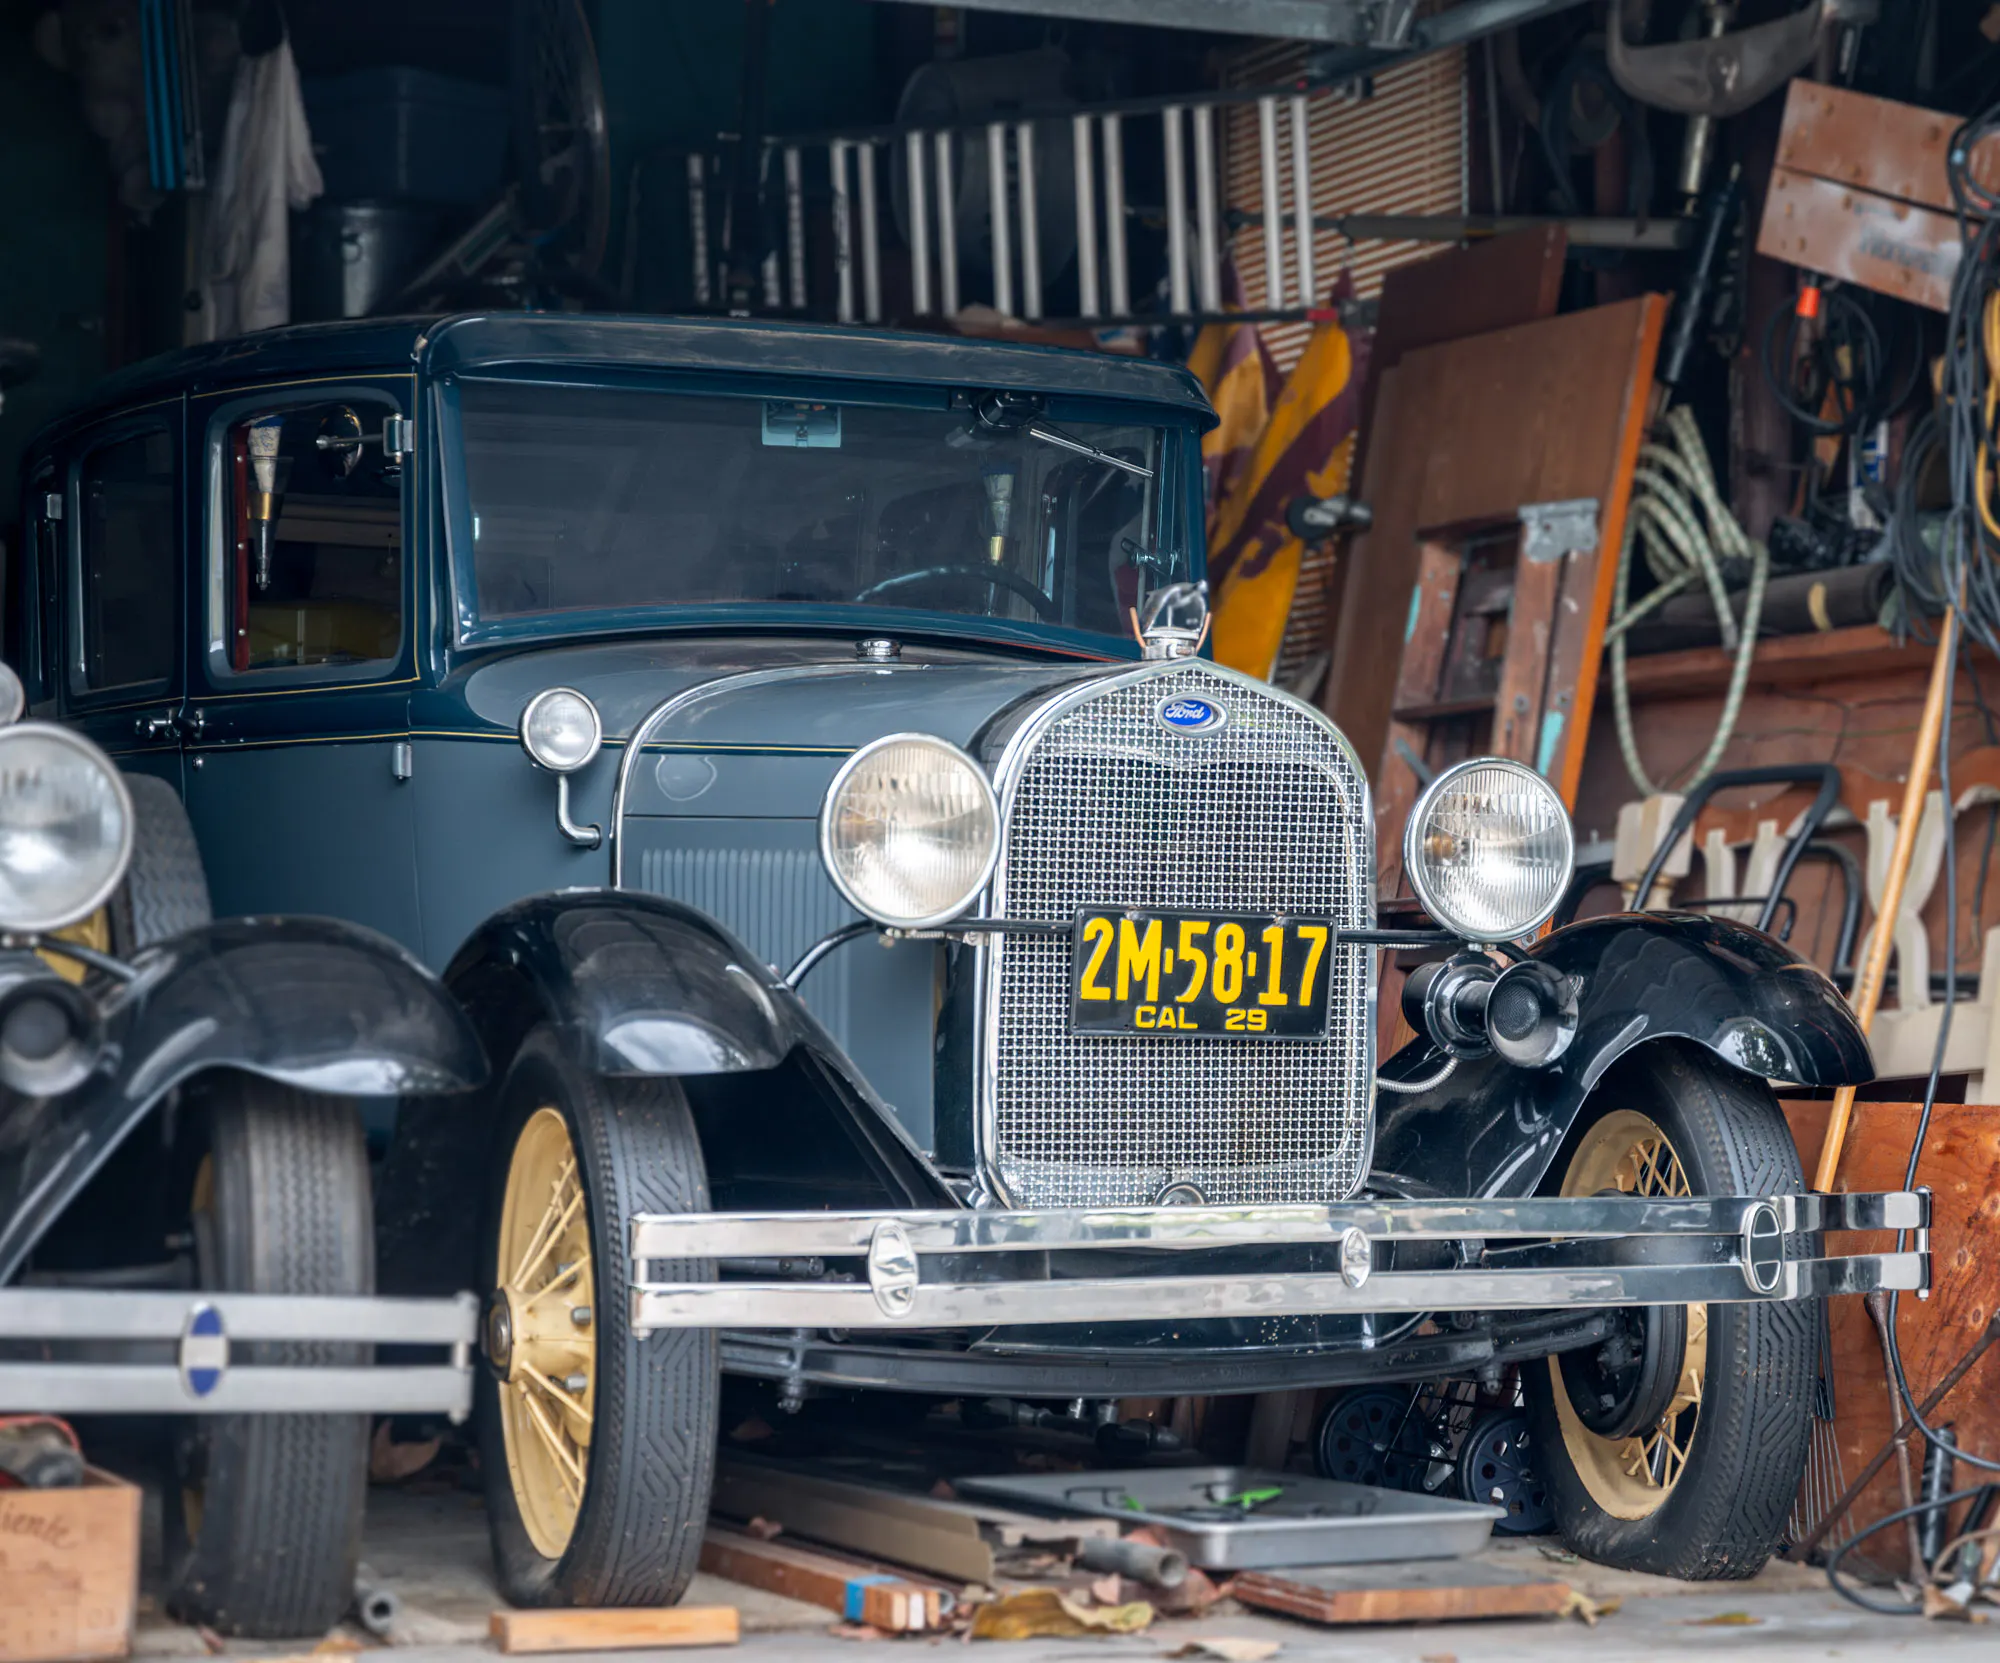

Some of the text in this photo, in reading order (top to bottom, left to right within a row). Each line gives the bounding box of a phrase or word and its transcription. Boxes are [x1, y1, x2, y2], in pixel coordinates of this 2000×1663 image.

[1165, 701, 1205, 719] Ford
[1135, 1006, 1267, 1031] CAL 29
